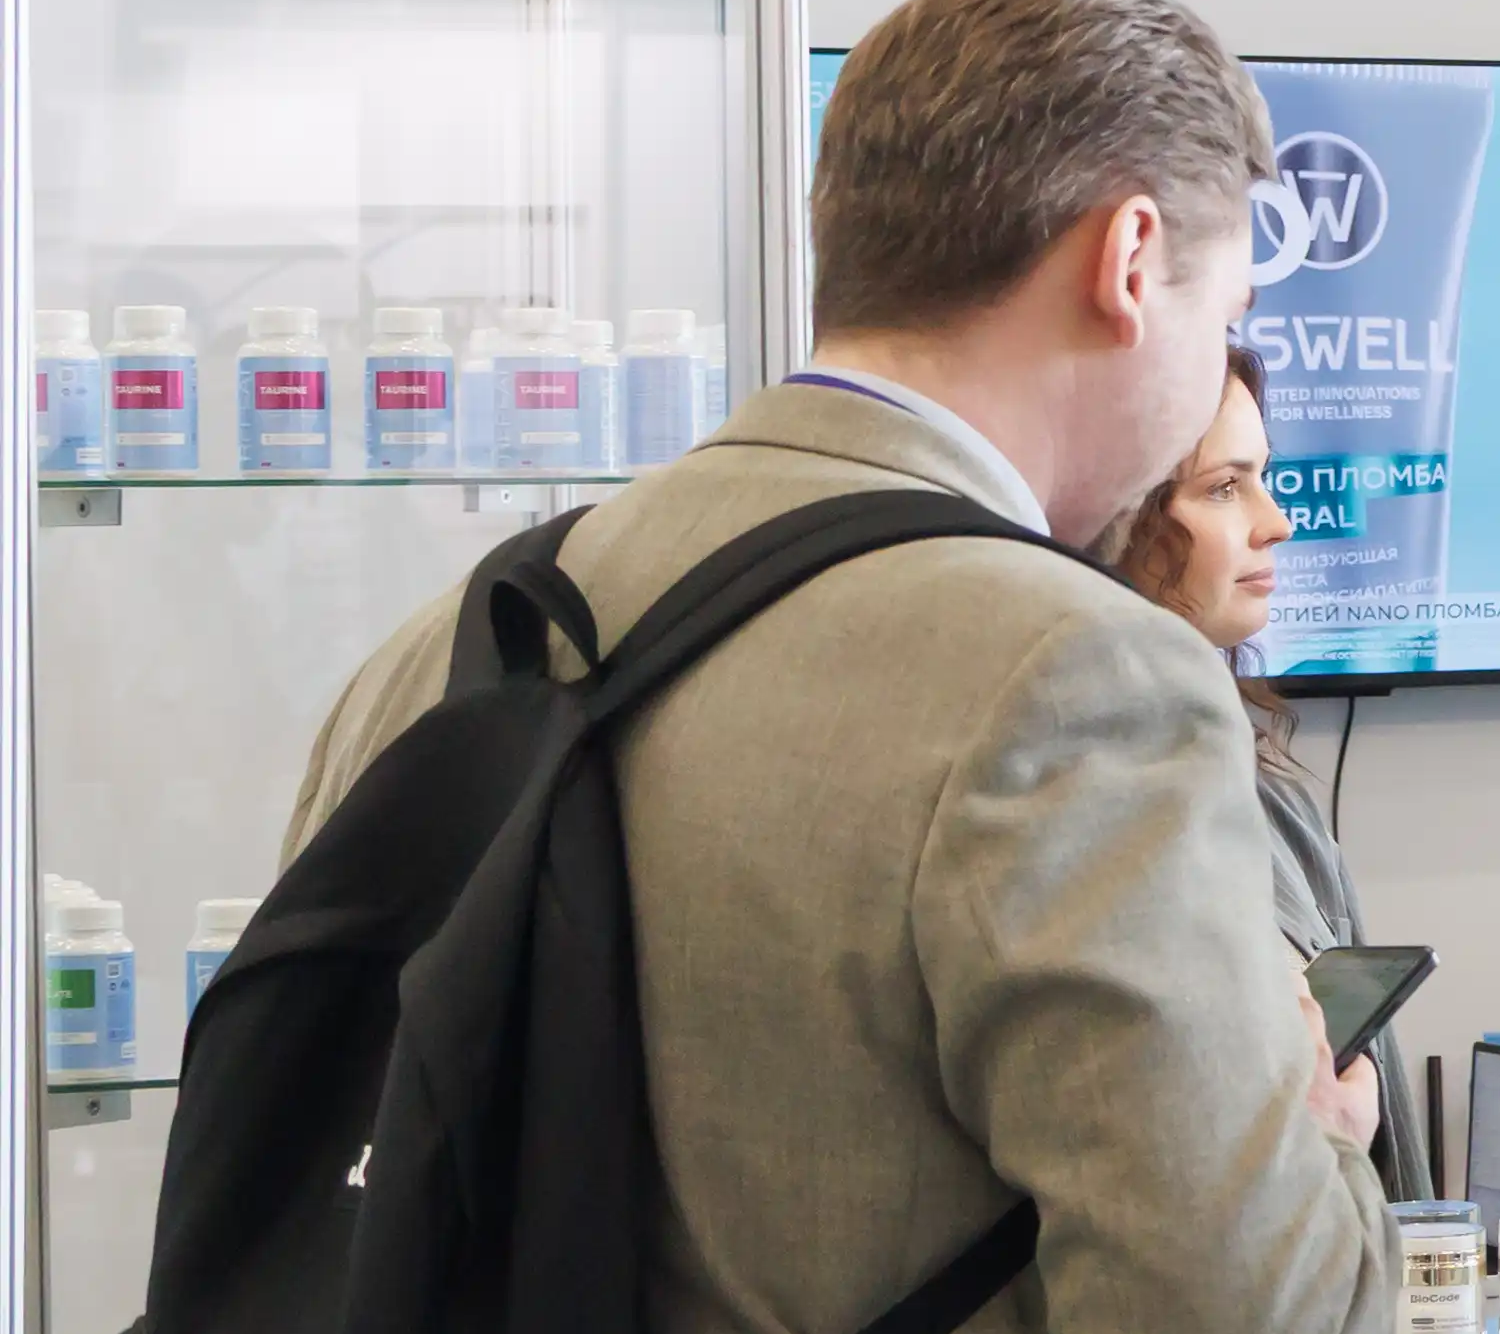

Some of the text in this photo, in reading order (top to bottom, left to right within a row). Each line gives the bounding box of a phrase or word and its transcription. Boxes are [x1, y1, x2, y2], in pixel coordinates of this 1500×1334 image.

[1236, 315, 1456, 372] SWELL
[259, 385, 308, 396] TAURINE
[380, 384, 428, 396] TAURINE
[1266, 386, 1422, 403] STED INNOVATIONS
[1270, 405, 1393, 422] FOR WELLNESS
[1313, 462, 1446, 493] ПЛОМБА
[1268, 603, 1340, 624] ОГИЕЙ
[1347, 603, 1409, 622] NANO
[1410, 1292, 1461, 1304] BioCode
